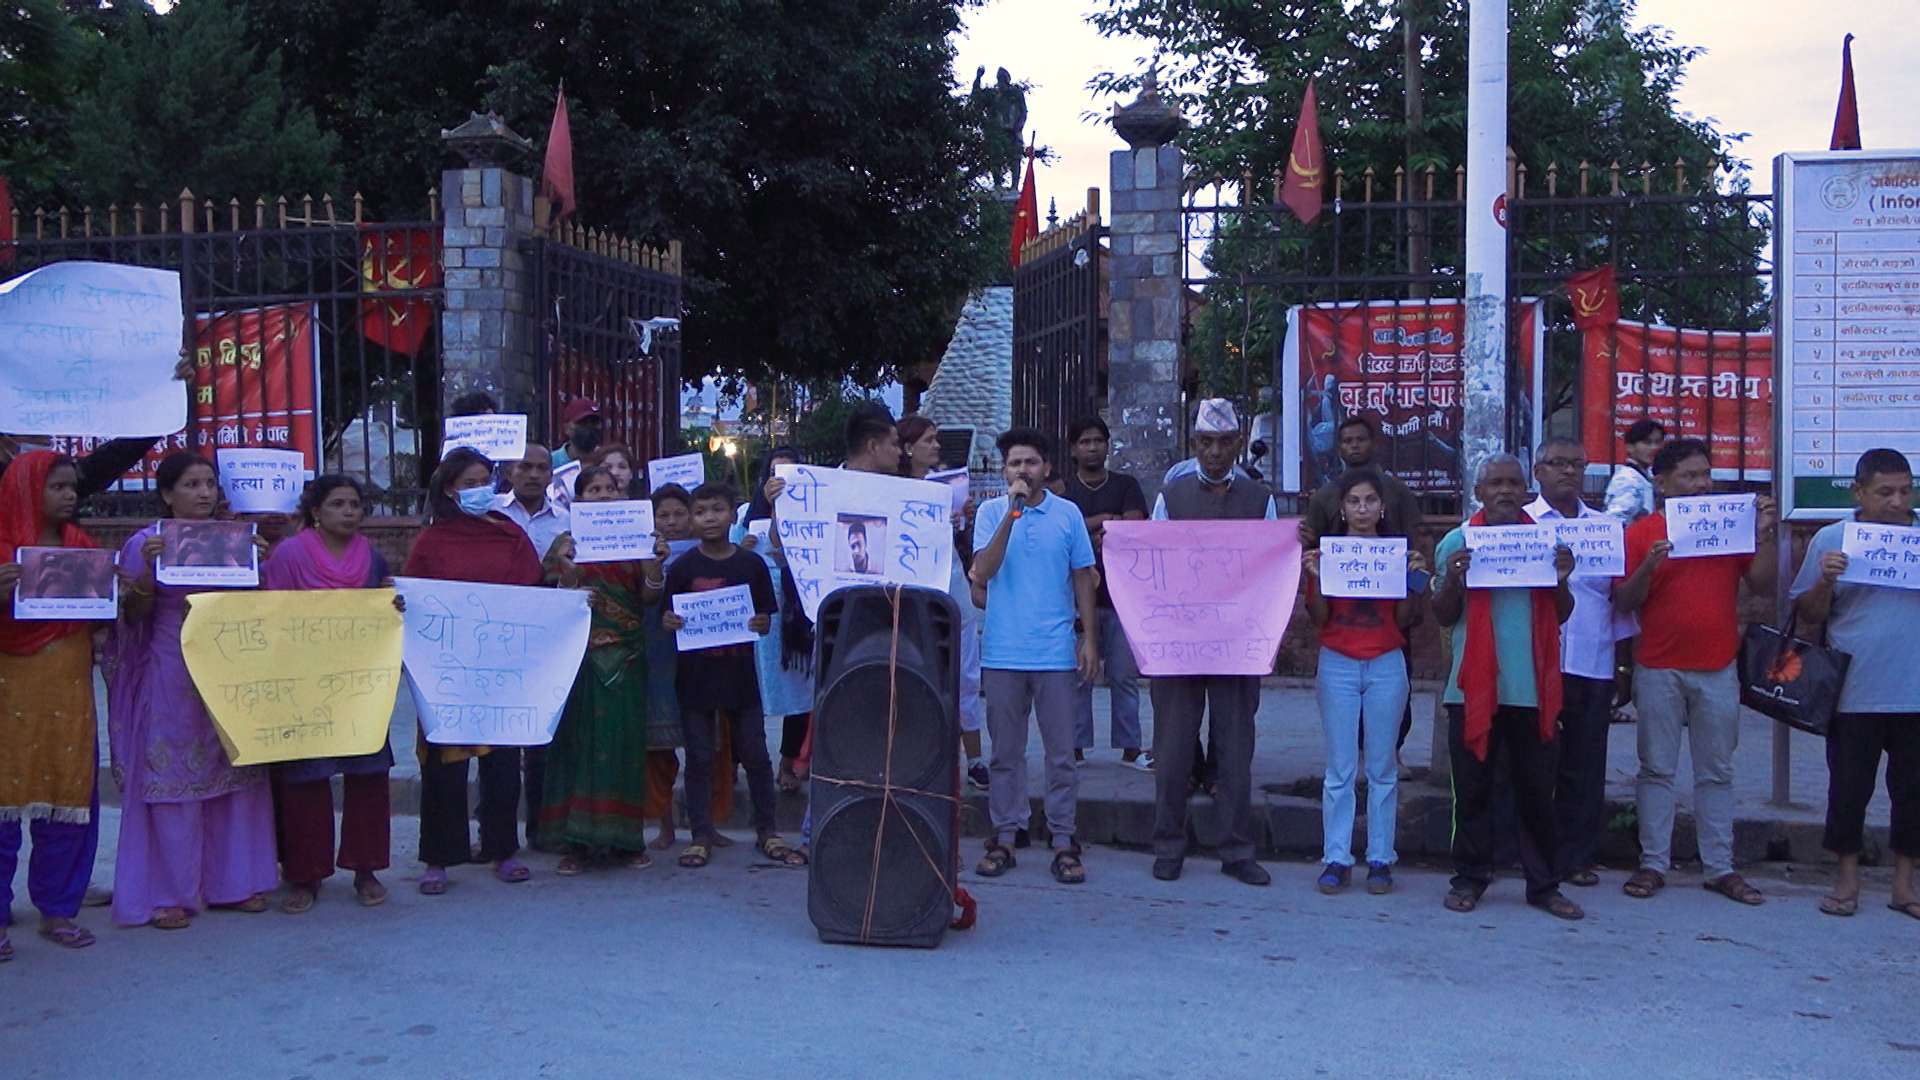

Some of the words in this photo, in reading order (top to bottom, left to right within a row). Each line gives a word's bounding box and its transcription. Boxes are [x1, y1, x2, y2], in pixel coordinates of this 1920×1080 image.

[1809, 458, 1824, 469] १०
[231, 478, 265, 491] हत्या
[271, 473, 285, 491] हो
[787, 466, 828, 512] यो
[900, 499, 948, 530] हत्या
[1677, 502, 1692, 515] कि
[1698, 501, 1711, 513] यो
[1718, 501, 1746, 513] संकट
[1723, 517, 1738, 529] कि
[1695, 534, 1720, 549] हामी
[1856, 528, 1873, 541] कि
[1331, 543, 1345, 554] कि
[1351, 542, 1362, 555] यो
[895, 534, 930, 579] हो
[1120, 537, 1178, 591] यो
[1186, 527, 1249, 590] देश
[1374, 559, 1388, 571] कि
[1869, 566, 1898, 579] हामी
[1347, 577, 1371, 590] हामी
[418, 594, 464, 651] यो
[472, 592, 549, 661] देश
[208, 616, 269, 665] साहु
[281, 616, 392, 646] महाजन
